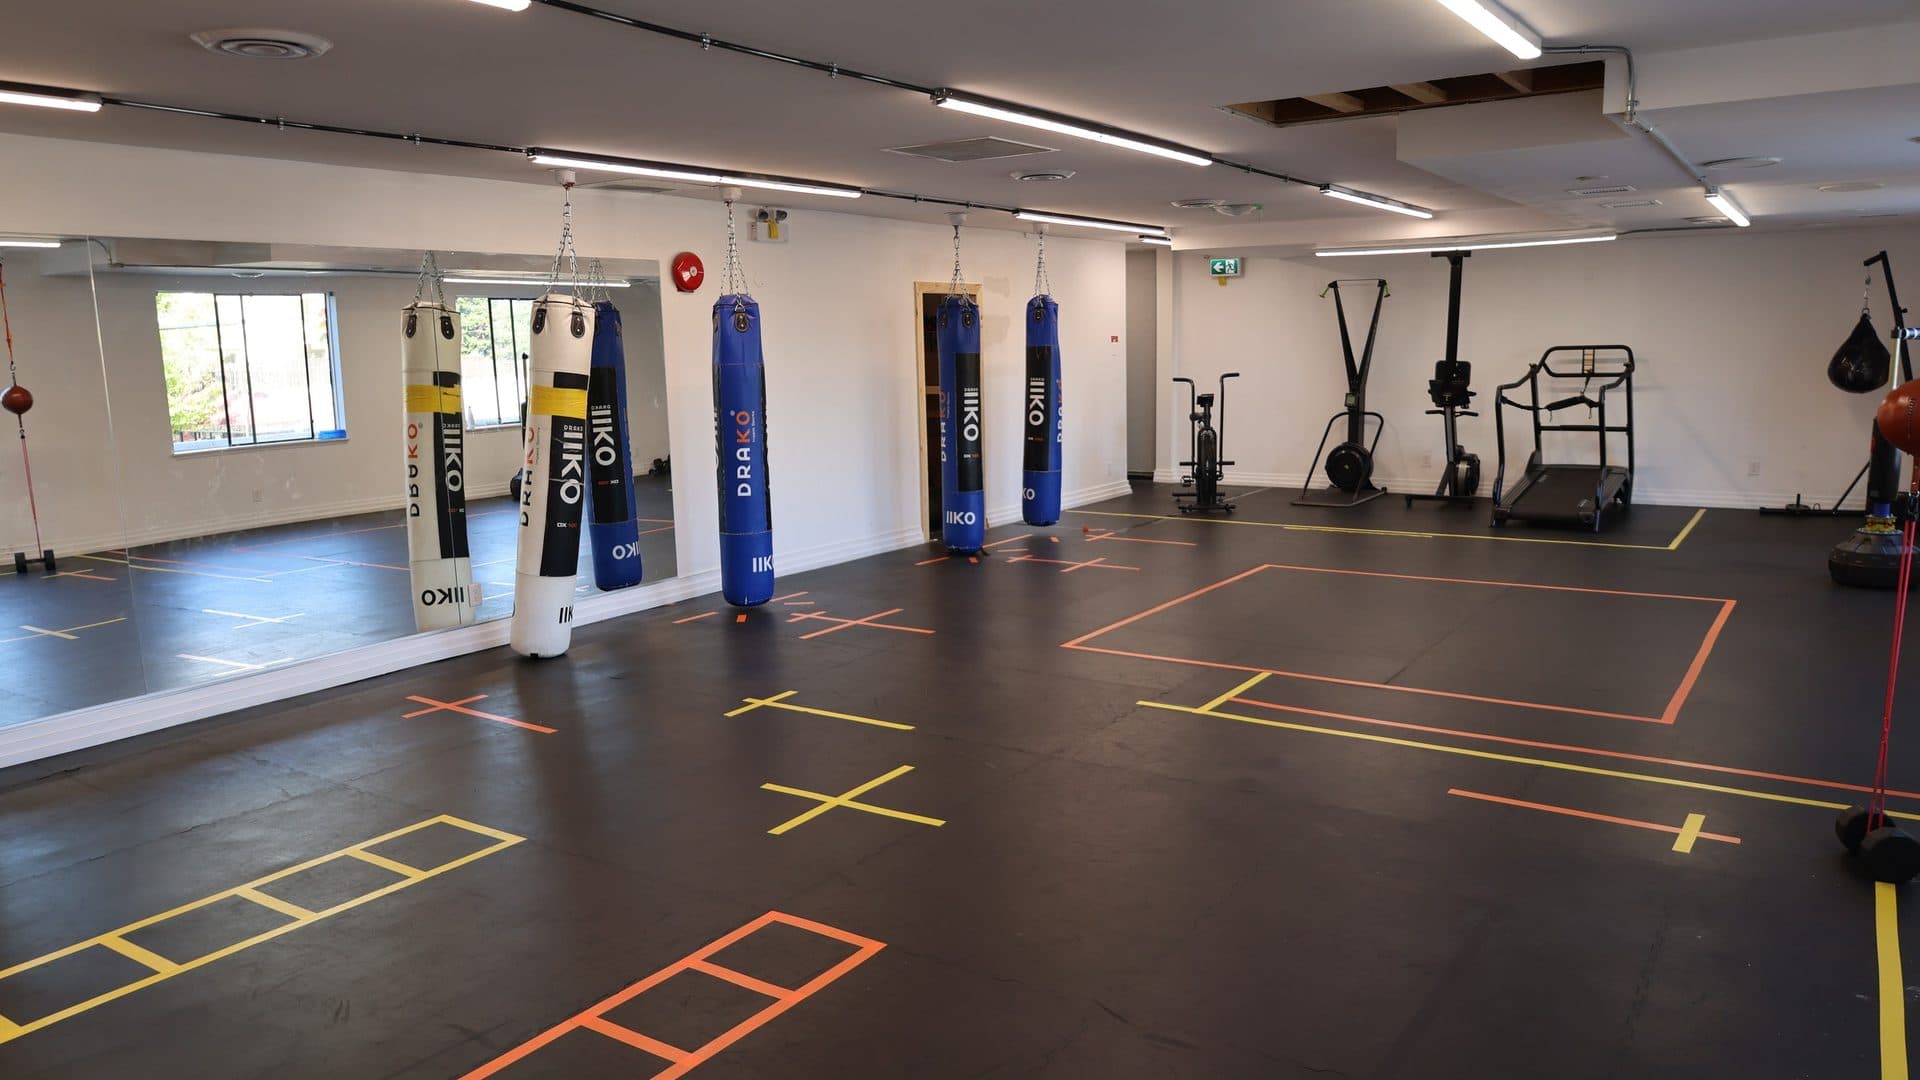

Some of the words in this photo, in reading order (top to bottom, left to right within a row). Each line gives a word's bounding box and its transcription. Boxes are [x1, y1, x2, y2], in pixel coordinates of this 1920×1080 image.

[963, 392, 979, 442] IIKO
[1029, 381, 1045, 426] IIKO
[560, 431, 583, 504] IIKO
[736, 410, 751, 497] DRAKO
[946, 510, 976, 525] IIKO
[752, 555, 774, 573] IIK
